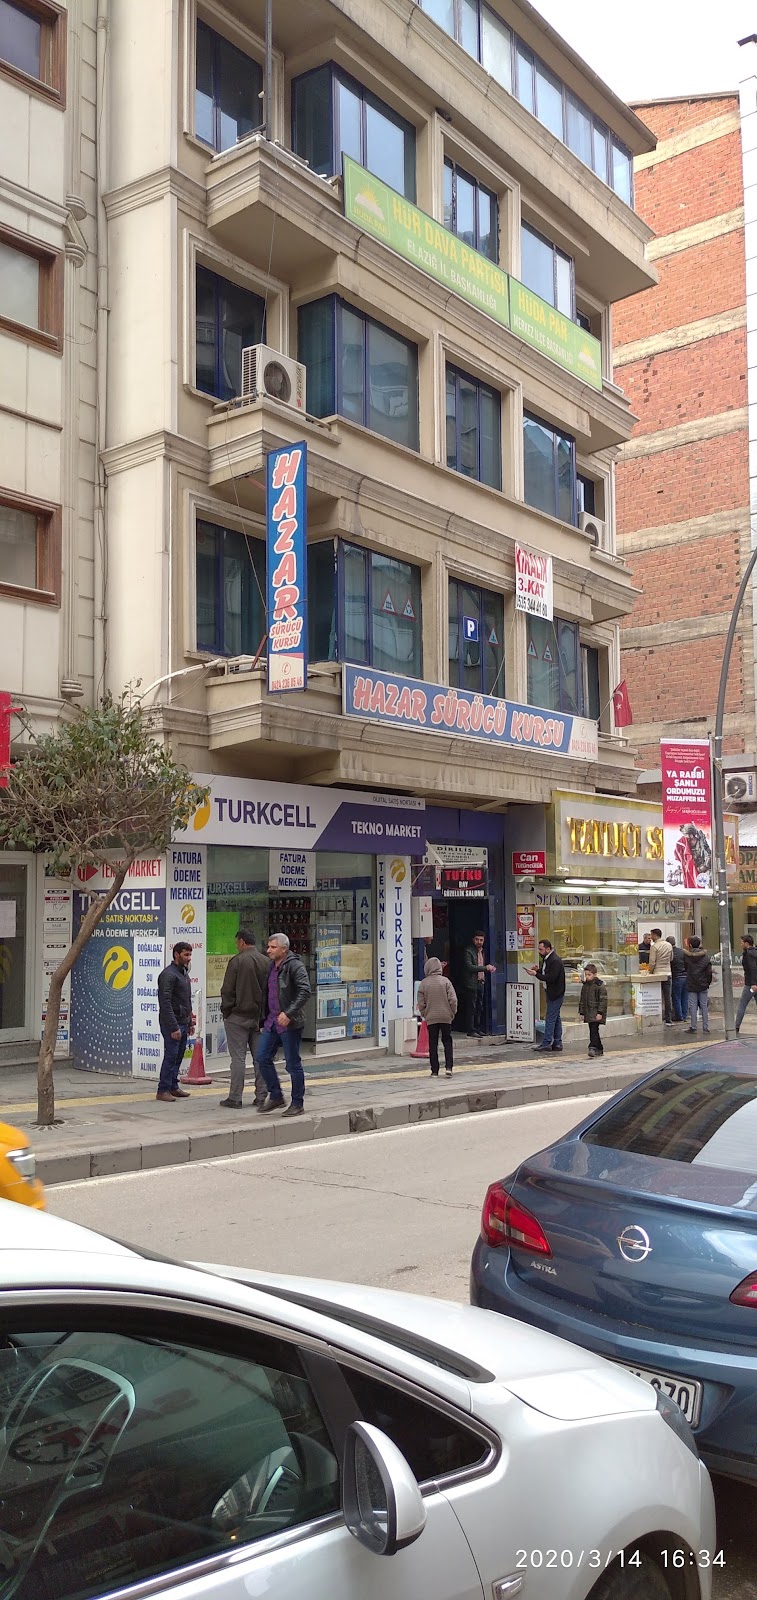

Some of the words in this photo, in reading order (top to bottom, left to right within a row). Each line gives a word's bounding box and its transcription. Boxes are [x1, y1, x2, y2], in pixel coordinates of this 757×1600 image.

[392, 196, 421, 238] HÜR
[424, 220, 458, 263] DAVA
[461, 247, 505, 296] PARTİSİ
[407, 239, 438, 271] ELAZIĞ
[450, 269, 497, 311] BAŞKANLIĞI
[517, 288, 546, 327] HÜDA
[549, 311, 568, 342] PAR
[513, 313, 534, 339] MERKEZ
[272, 449, 302, 620] HAZAR
[518, 577, 545, 598] 3.KAT
[269, 617, 303, 638] SÜRÜCÜ
[272, 633, 301, 650] KURSU
[353, 676, 427, 724] HAZAR
[431, 689, 507, 736] SÜRÜCÜ
[511, 710, 564, 747] KURSU
[666, 770, 677, 778] YA
[674, 779, 698, 788] ŞANLI
[666, 795, 696, 803] MUZAFFER
[214, 797, 316, 828] TURKCELL
[351, 821, 383, 836] TEKNO
[386, 823, 421, 838] MARKET
[172, 851, 202, 864] FATURA
[279, 853, 306, 863] FATURA
[520, 853, 538, 861] Can
[128, 859, 161, 877] MARKET
[281, 863, 305, 875] ÖDEME
[173, 867, 201, 882] ÖDEME
[444, 869, 482, 880] TUTKU
[278, 876, 308, 887] MERKEZİ
[458, 880, 469, 888] BAY
[170, 887, 204, 900] MERKEZİ
[465, 889, 485, 897] SALONU
[105, 914, 124, 925] SATIŞ
[124, 914, 153, 923] NOKTASI
[105, 927, 129, 938] ÖDEME
[130, 927, 159, 937] MERKEZİ
[172, 926, 202, 935] TURKCELL
[137, 943, 162, 952] DOĞALGAZ
[394, 886, 404, 1009] TURKCELL
[139, 958, 160, 967] ELEKTRİK
[146, 974, 152, 982] SU
[137, 987, 159, 997] DOĞALGA
[140, 1003, 157, 1012] CEPTEL
[515, 991, 523, 1030] ERKEK
[137, 1031, 160, 1042] İNTERNET
[137, 1047, 160, 1057] FATURASI
[140, 1062, 156, 1072] ALINIR
[530, 1260, 558, 1276] ASTRA
